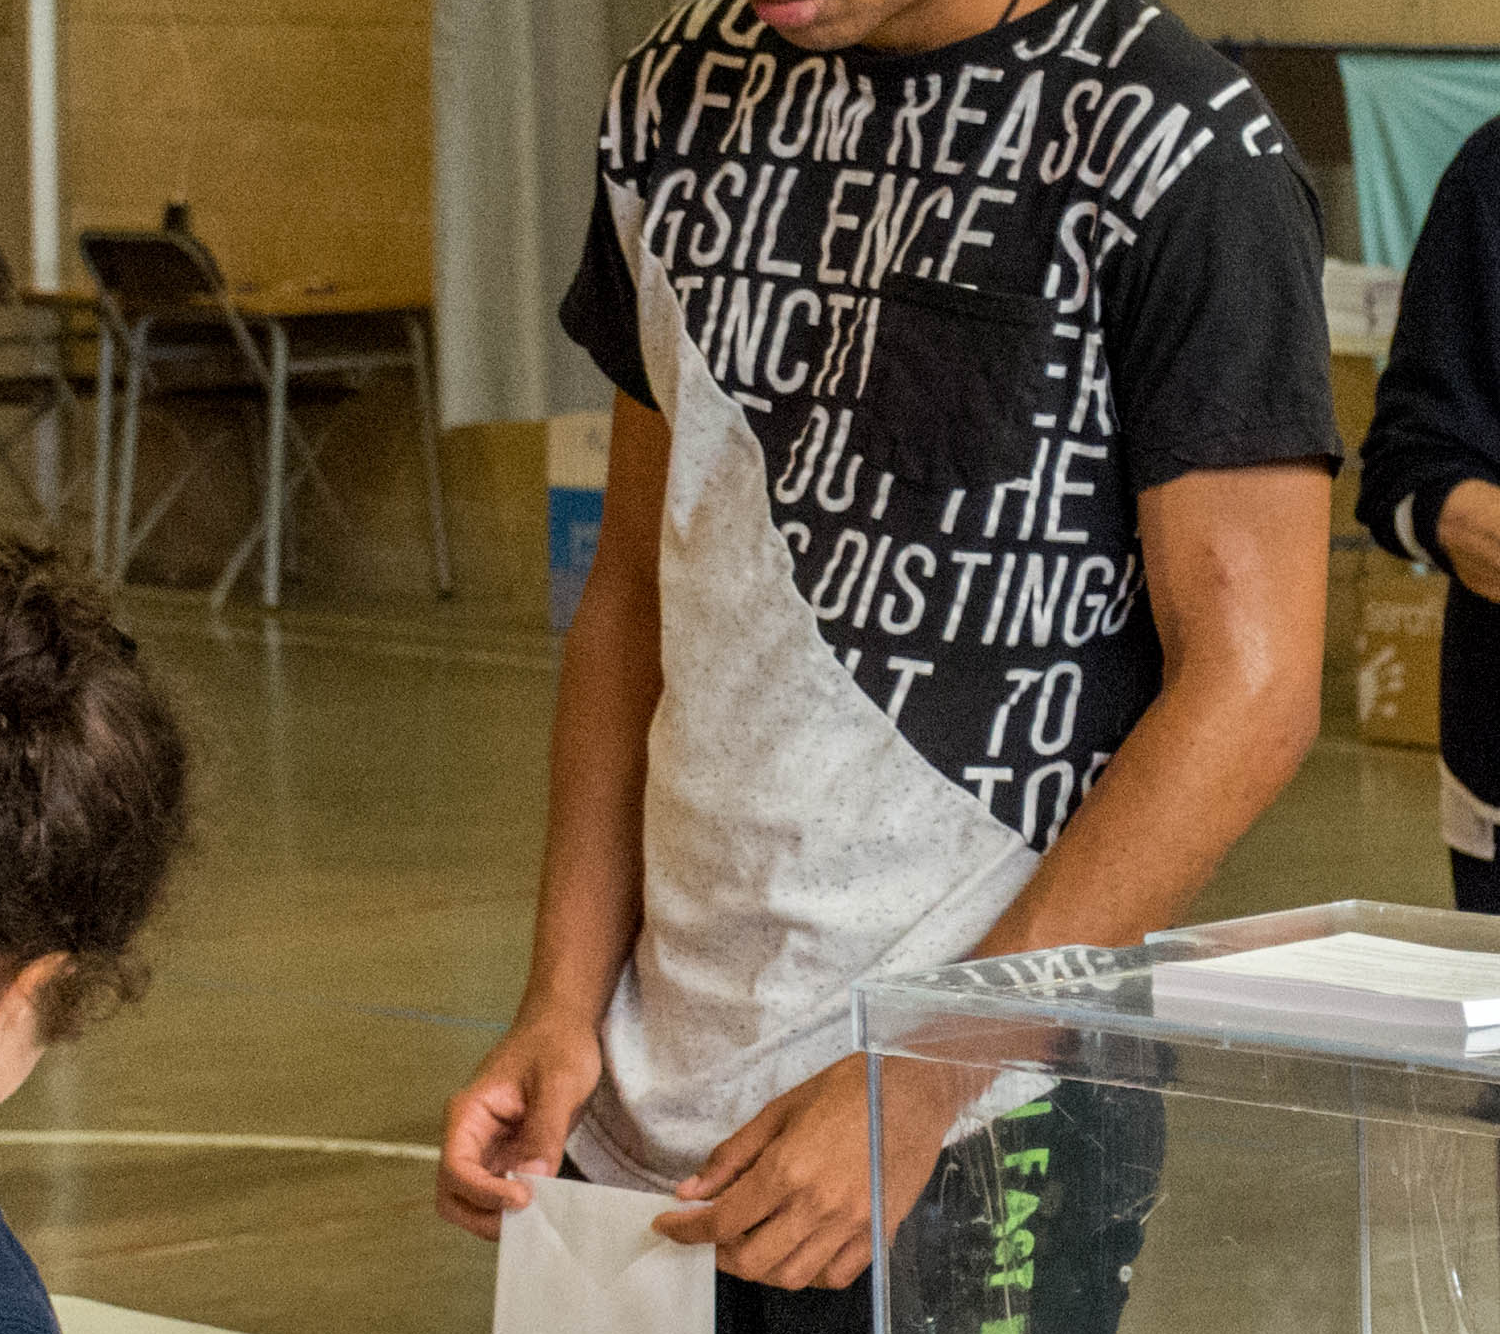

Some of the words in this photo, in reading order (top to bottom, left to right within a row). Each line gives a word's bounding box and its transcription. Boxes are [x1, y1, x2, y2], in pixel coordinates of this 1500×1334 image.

[677, 51, 876, 163] FROM
[886, 64, 1215, 220] REASON
[986, 660, 1083, 759] TO
